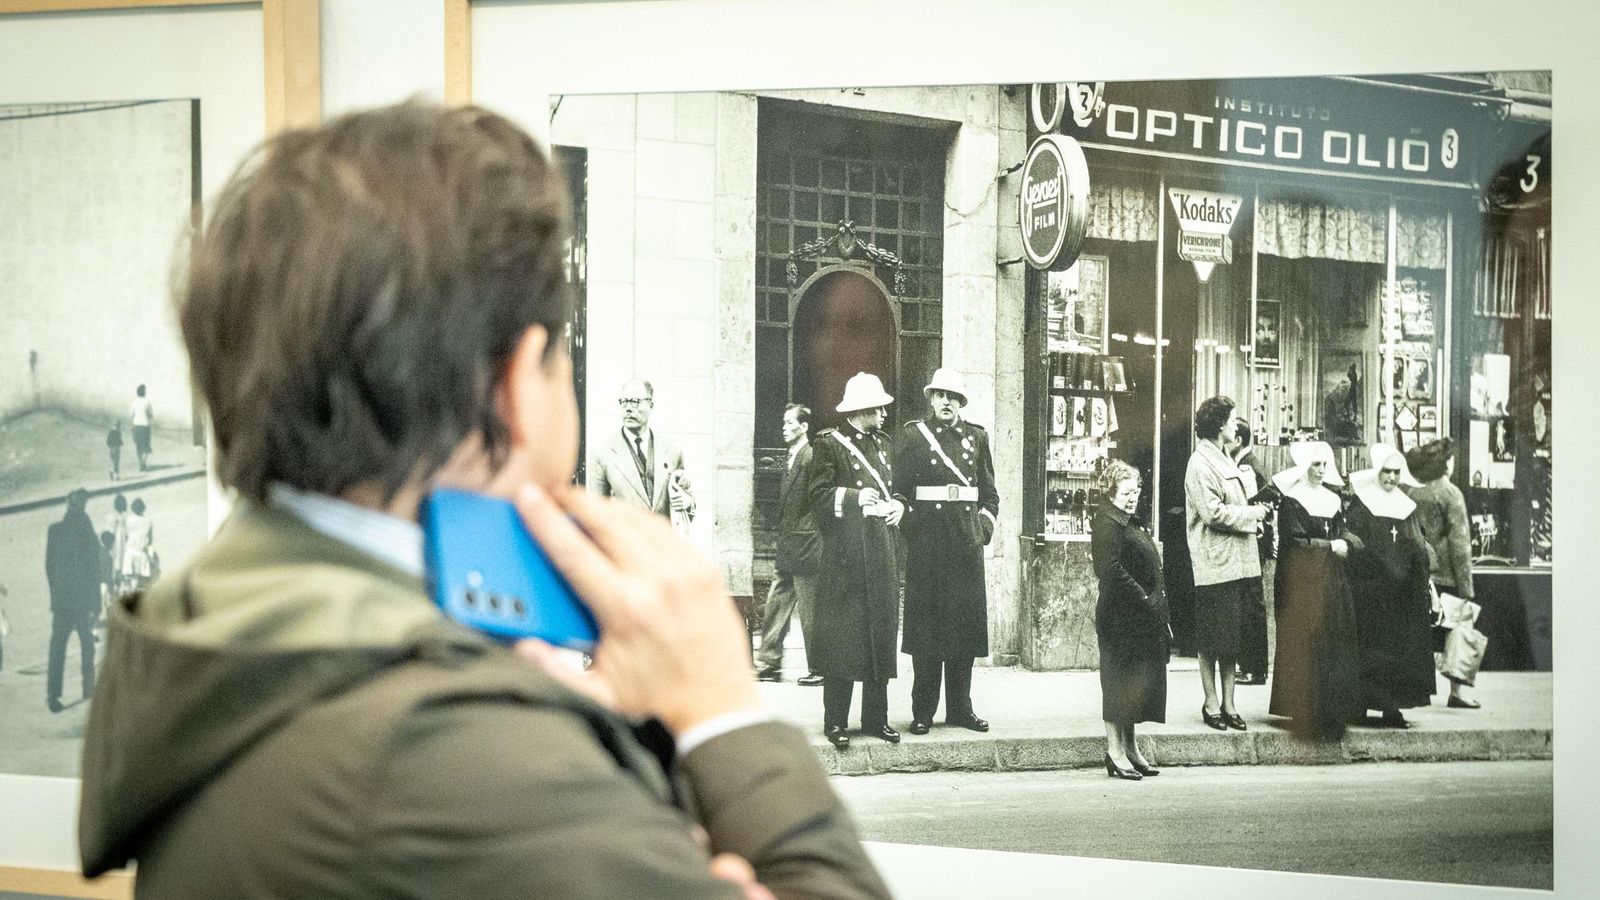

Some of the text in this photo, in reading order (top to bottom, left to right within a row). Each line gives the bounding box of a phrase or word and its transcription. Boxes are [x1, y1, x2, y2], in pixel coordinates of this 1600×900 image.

[1215, 96, 1330, 121] INSTITUTO
[1106, 104, 1302, 160] OPTICO
[1323, 130, 1429, 172] OLIO
[1519, 154, 1542, 193] 3
[1034, 212, 1056, 231] FILM
[1183, 236, 1222, 248] VERICHROME
